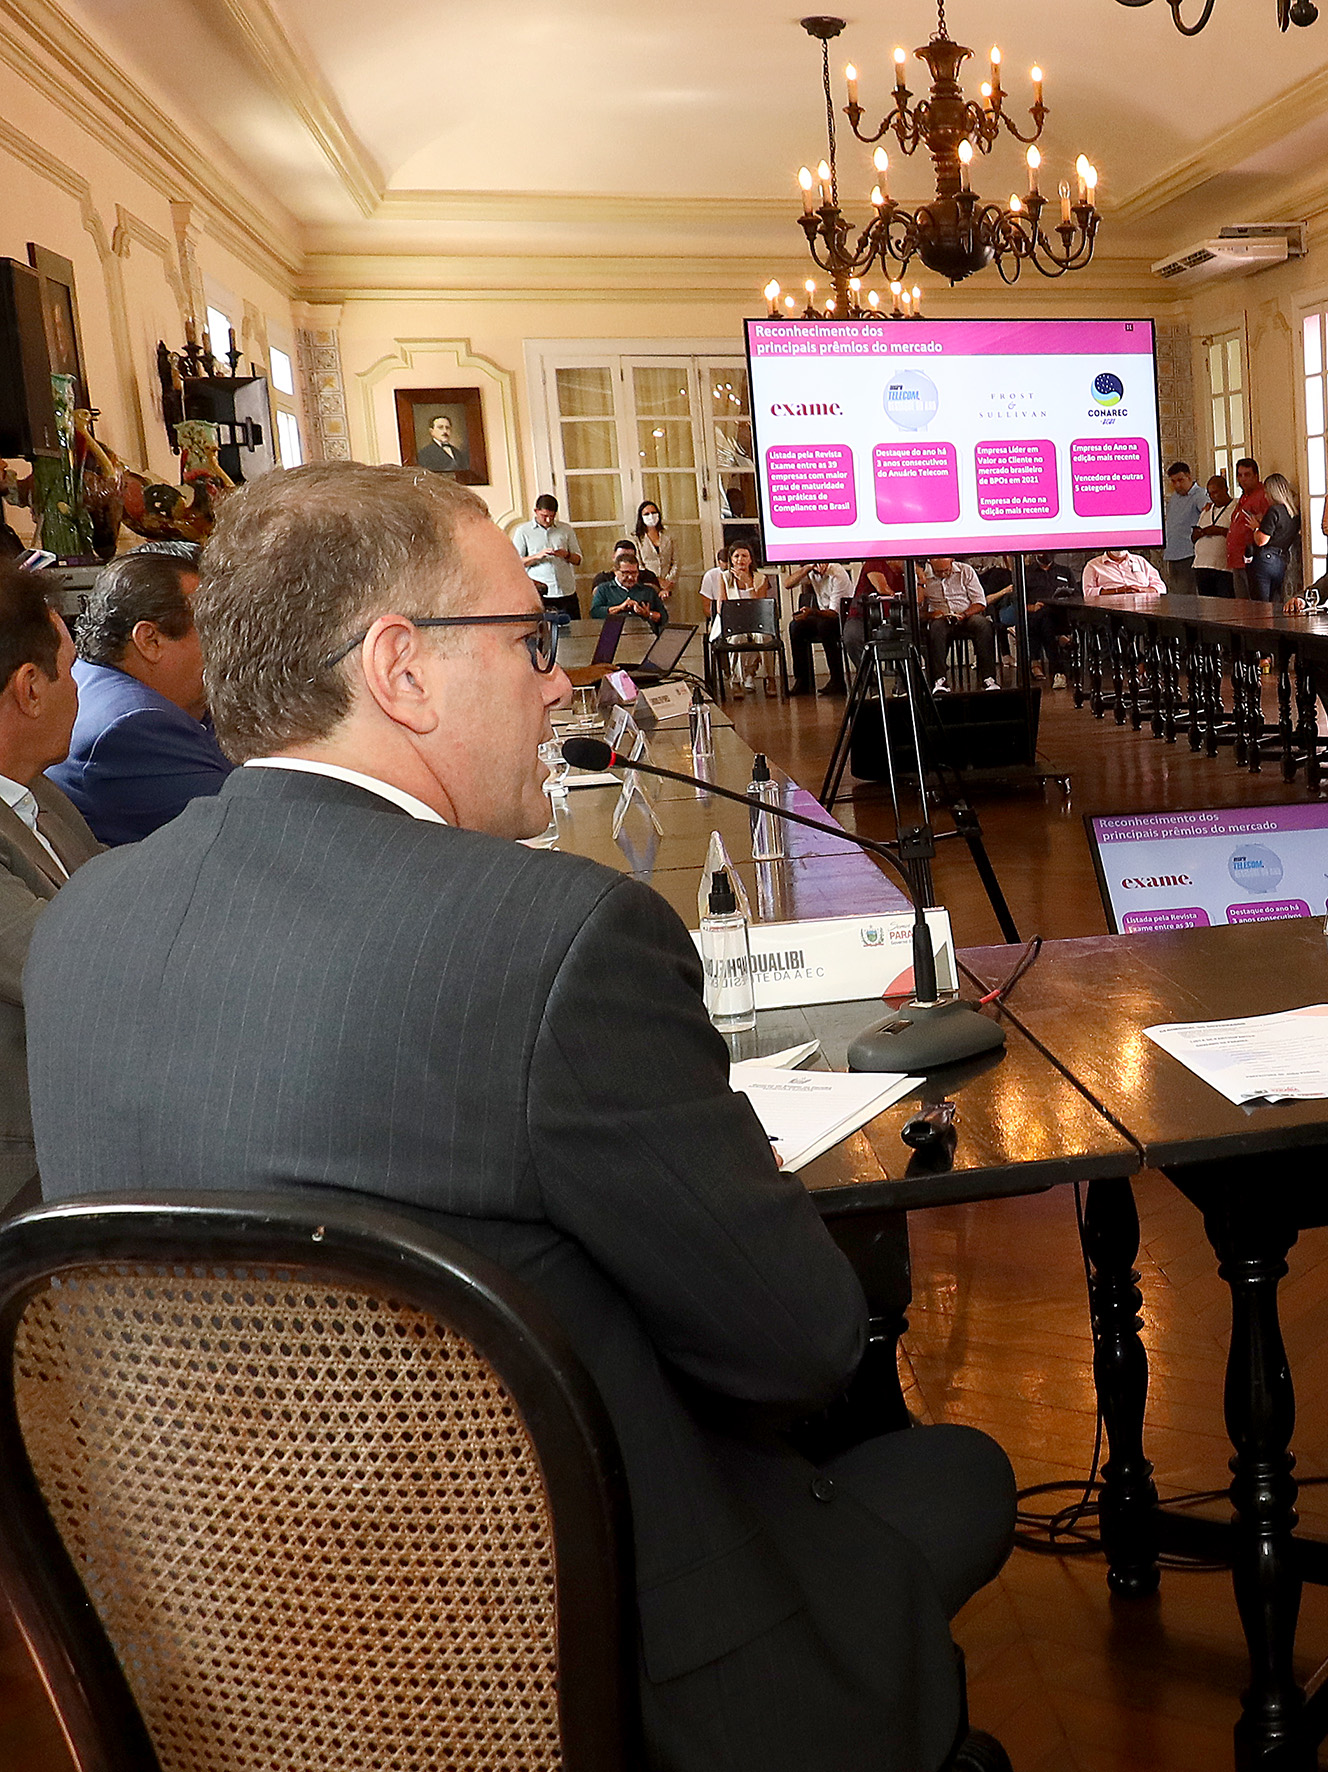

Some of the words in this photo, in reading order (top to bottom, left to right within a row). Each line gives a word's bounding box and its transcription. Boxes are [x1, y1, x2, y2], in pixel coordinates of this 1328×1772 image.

[756, 325, 859, 337] Reconhecimento
[861, 325, 883, 336] dos
[757, 342, 817, 355] principais
[819, 341, 870, 355] prêmios
[871, 341, 888, 353] do
[890, 341, 943, 353] mercado
[1007, 401, 1016, 409] &
[979, 410, 1047, 418] SULLIVAN
[1088, 409, 1128, 417] CONAREC
[876, 449, 910, 457] Destaque
[911, 448, 921, 456] do
[937, 447, 947, 456] há
[977, 447, 1007, 455] Empresa
[1008, 446, 1026, 454] Líder
[1072, 444, 1102, 452] Empresa
[1113, 443, 1127, 451] Ano
[769, 451, 796, 459] Listada
[797, 451, 814, 460] pela
[815, 450, 842, 458] Revista
[1008, 456, 1032, 464] Cliente
[1073, 454, 1096, 463] edição
[1114, 453, 1140, 461] recente
[770, 461, 795, 469] Exame
[796, 461, 817, 469] entre
[827, 461, 837, 469] 39
[877, 459, 882, 467] 3
[901, 458, 948, 466] consecutivos
[877, 469, 887, 477] do
[888, 468, 917, 477] Anuário
[919, 468, 948, 476] Telecom
[978, 467, 1009, 475] mercado
[1010, 466, 1043, 474] brasileiro
[771, 472, 808, 481] empresas
[825, 471, 848, 479] maior
[979, 477, 988, 485] de
[1074, 474, 1111, 482] Vencedora
[1112, 473, 1121, 481] de
[772, 484, 790, 492] grau
[790, 482, 800, 491] de
[801, 482, 844, 490] maturidade
[1075, 484, 1080, 492] 5
[1080, 484, 1116, 493] categorias
[787, 492, 817, 503] práticas
[818, 492, 828, 500] de
[980, 497, 1010, 505] Empresa
[1022, 496, 1036, 504] Ano
[773, 503, 817, 512] Compliance
[829, 502, 850, 510] Brasil
[981, 507, 1004, 516] edição
[1005, 506, 1022, 514] mais
[1100, 814, 1196, 828] Reconhecimento
[1199, 813, 1219, 822] dos
[1103, 828, 1159, 842] principais
[1161, 826, 1208, 838] prêmios
[1211, 823, 1225, 834] do
[1228, 821, 1277, 832] mercado
[1230, 906, 1264, 916] Destaque
[1265, 905, 1274, 913] do
[1126, 914, 1153, 924] Listada
[1154, 914, 1170, 923] pela
[1171, 912, 1197, 921] Revista
[1128, 924, 1153, 933] Exame
[1154, 923, 1175, 931] entre
[774, 971, 791, 981] DA
